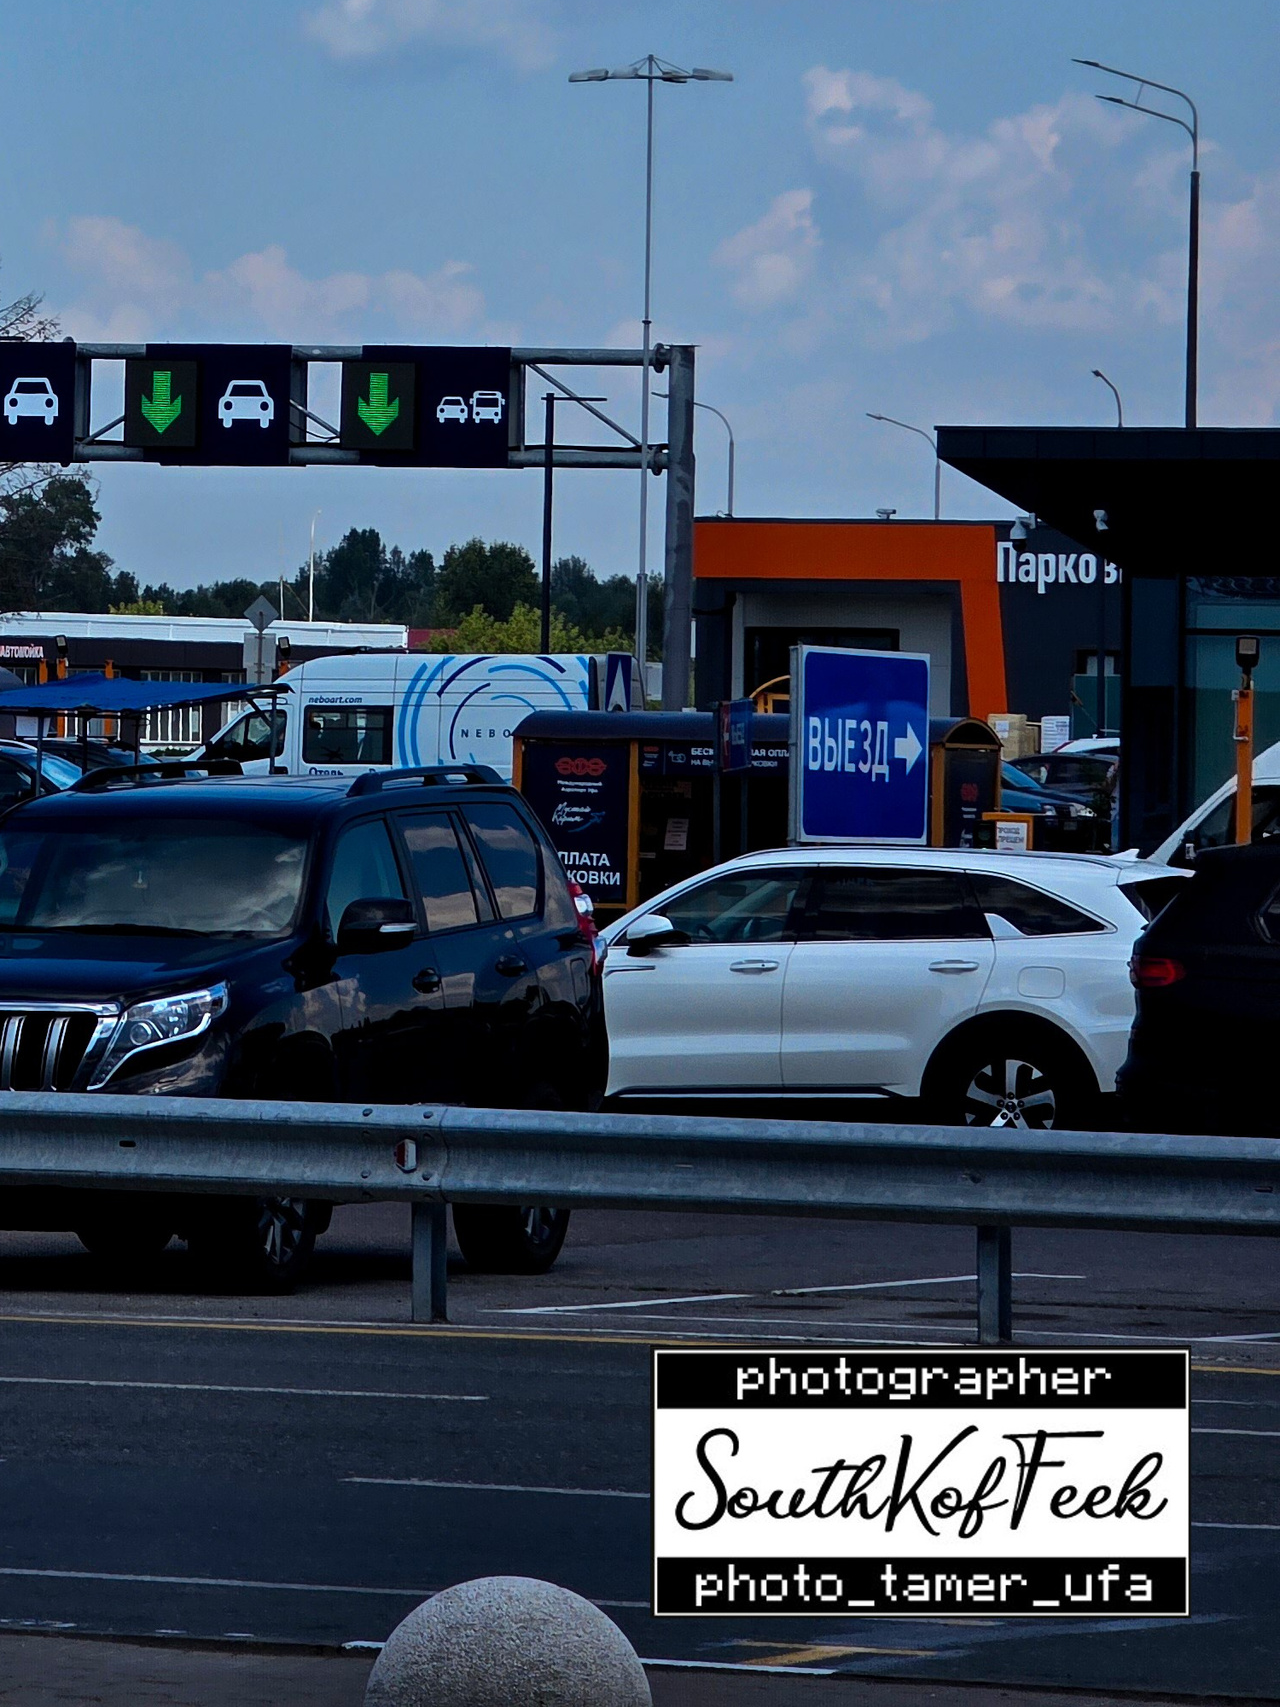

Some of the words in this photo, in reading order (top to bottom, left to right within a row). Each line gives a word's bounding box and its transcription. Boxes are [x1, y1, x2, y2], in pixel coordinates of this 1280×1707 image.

[997, 541, 1122, 594] Парков
[308, 696, 363, 704] neboart.com
[460, 729, 511, 738] NEBO
[808, 716, 890, 783] ВЫЕЗД
[557, 851, 611, 867] ПЛАТА
[567, 870, 620, 886] КОВКИ
